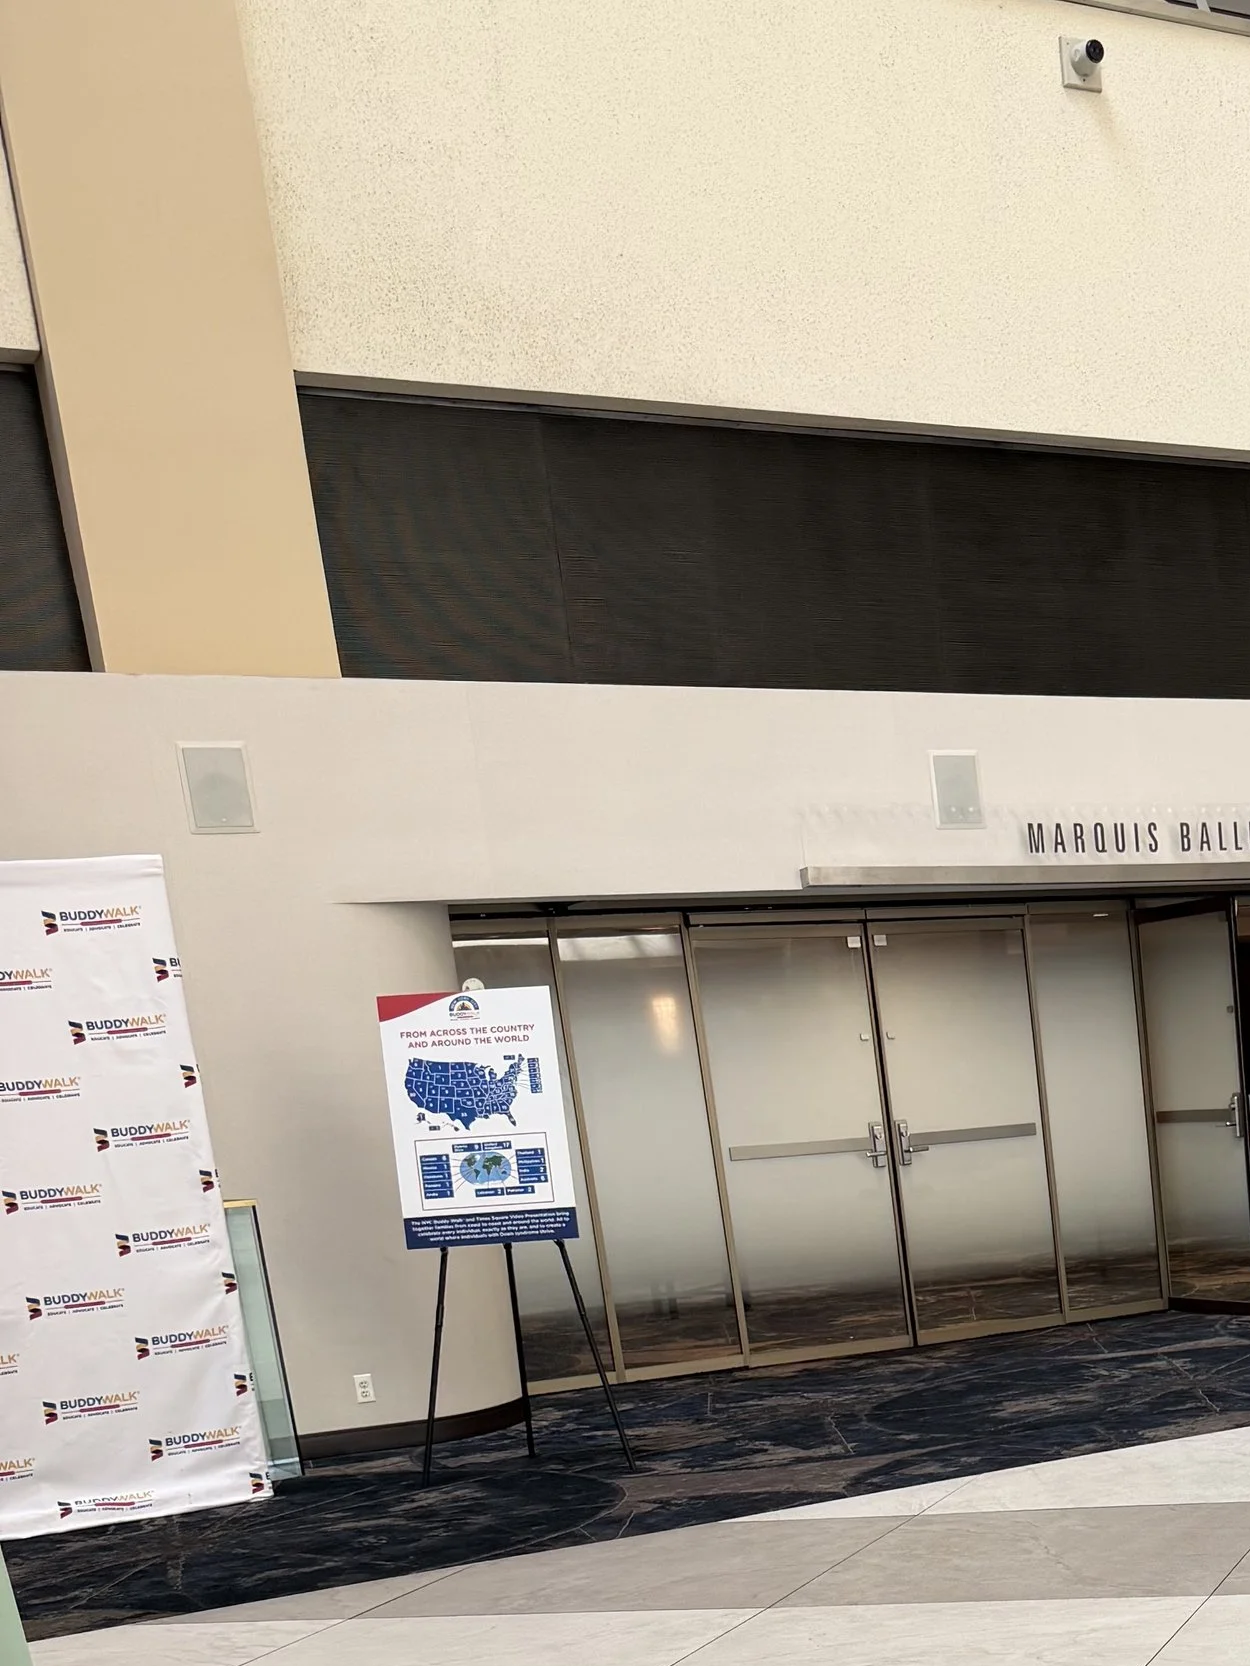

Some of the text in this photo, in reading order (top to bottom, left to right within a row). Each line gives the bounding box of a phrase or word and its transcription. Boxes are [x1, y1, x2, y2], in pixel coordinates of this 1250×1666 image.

[1027, 822, 1159, 853] MARQUIS
[59, 906, 139, 921] BUDDYWALK
[85, 1014, 165, 1031] BUDDYWALK
[400, 1024, 535, 1039] FROM ACROSS THE COUNTRY
[431, 1038, 471, 1047] AROUND
[474, 1036, 492, 1044] THE
[494, 1035, 529, 1043] WORLD
[111, 1120, 188, 1137] BUDDYWALK
[20, 1183, 100, 1200] BUDDYWALK
[132, 1224, 208, 1243] BUDDYWALK
[43, 1288, 122, 1306] BUDDYWALK
[151, 1326, 226, 1345] BUDDYWALK
[60, 1391, 137, 1410] BUDDYWALK
[165, 1426, 240, 1446] BUDDYWALK
